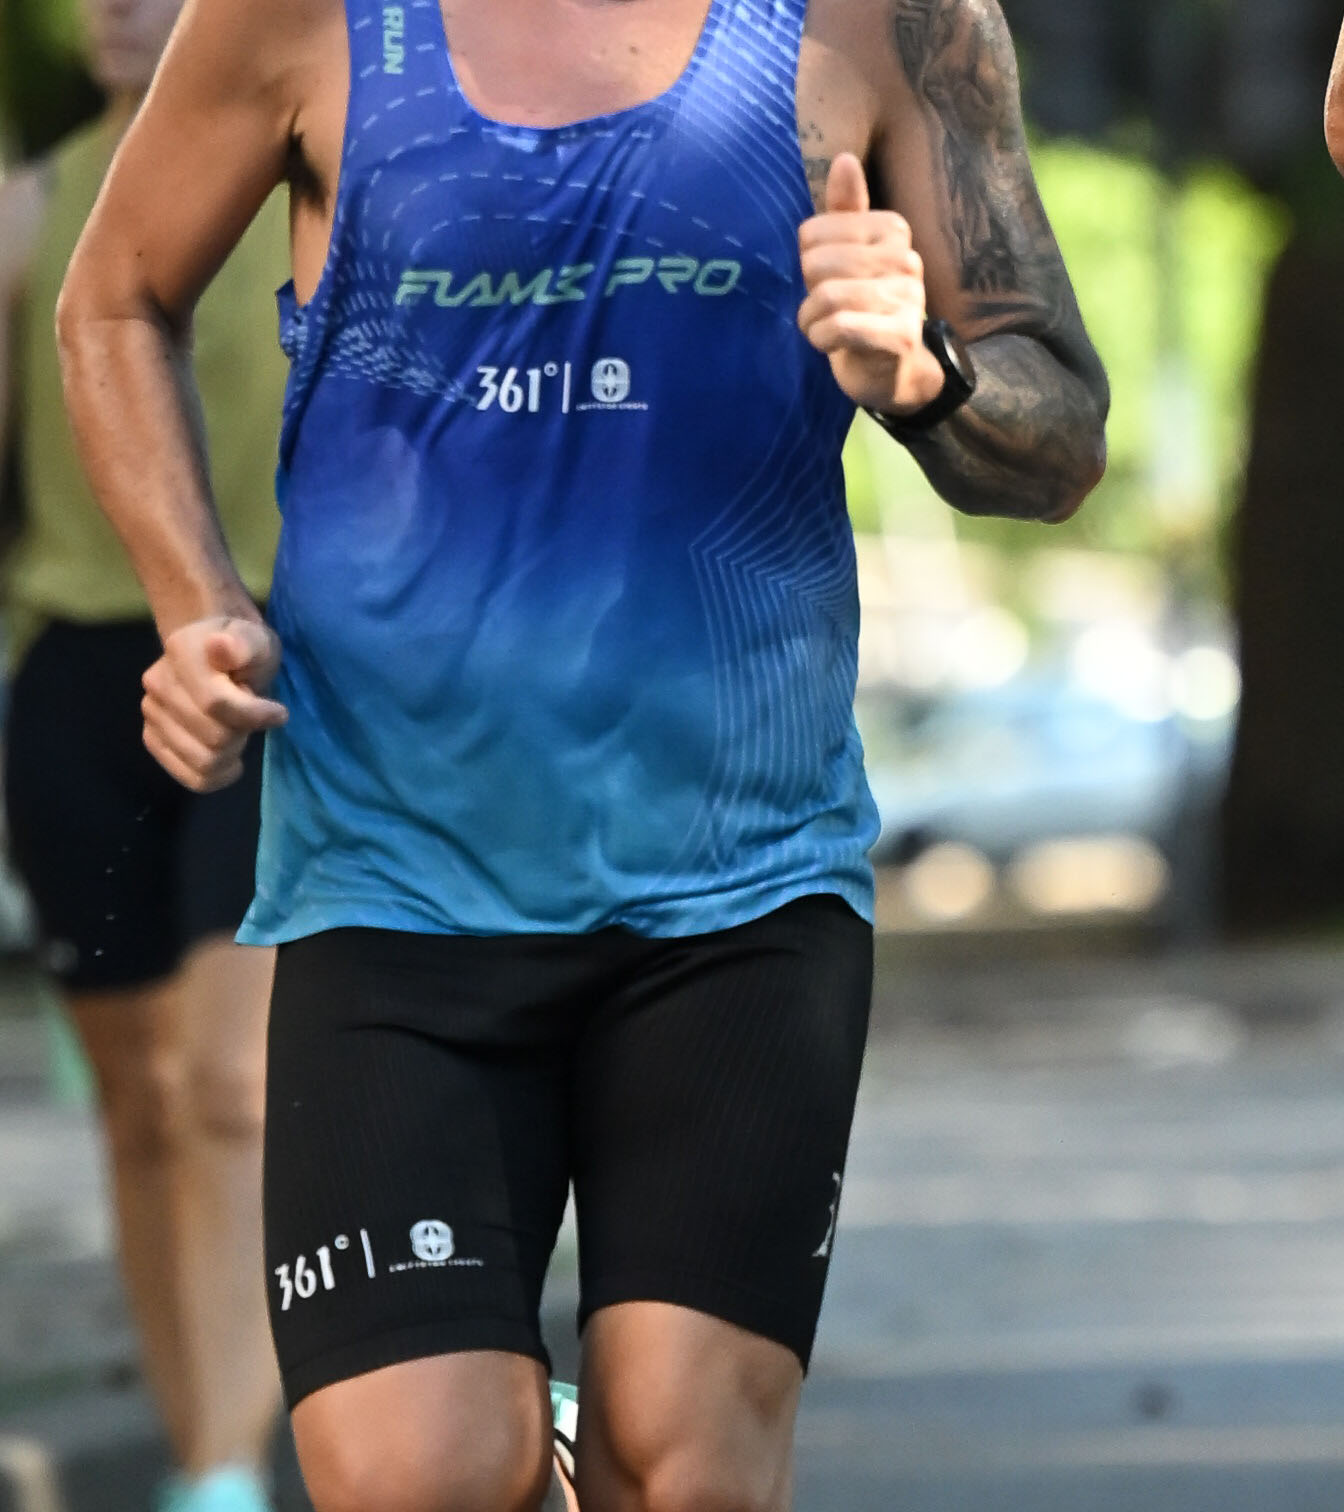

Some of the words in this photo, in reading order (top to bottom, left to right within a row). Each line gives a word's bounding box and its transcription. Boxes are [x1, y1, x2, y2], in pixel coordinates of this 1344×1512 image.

[394, 262, 595, 308] FLAME
[603, 256, 742, 297] PRO
[475, 361, 559, 413] 361°
[274, 1233, 350, 1312] 361°
